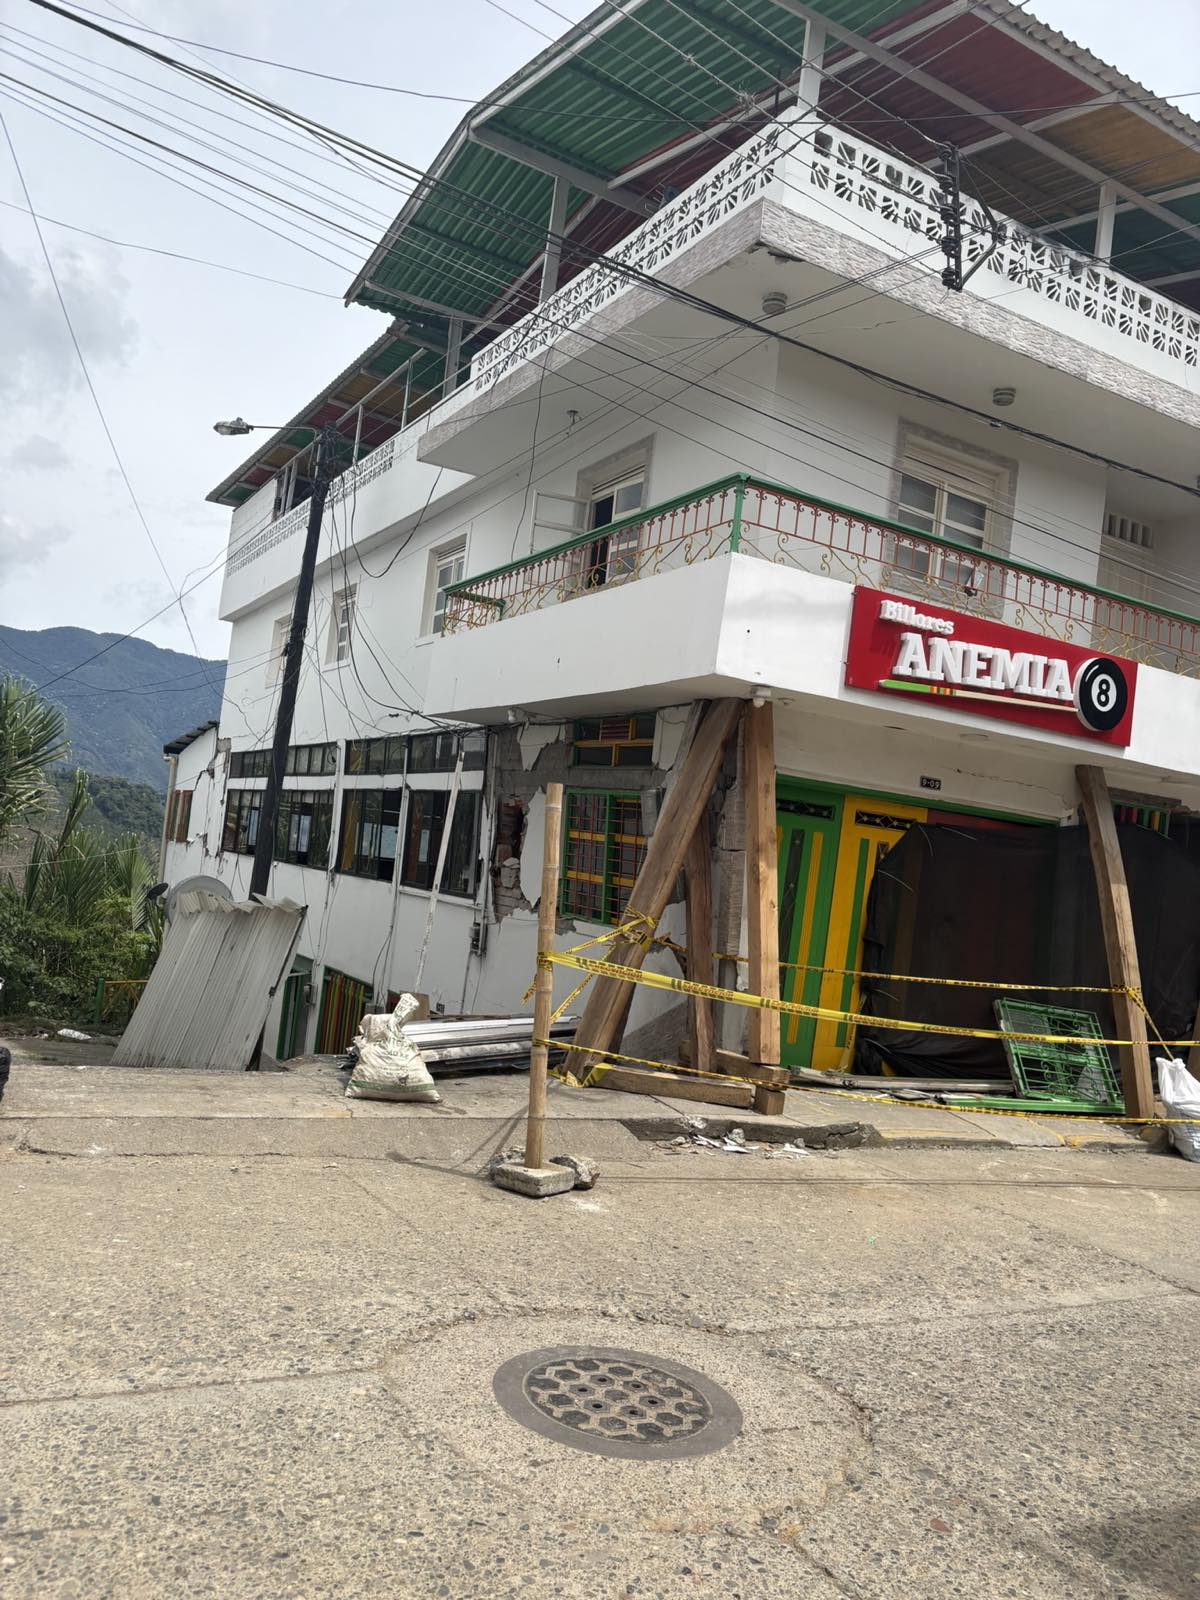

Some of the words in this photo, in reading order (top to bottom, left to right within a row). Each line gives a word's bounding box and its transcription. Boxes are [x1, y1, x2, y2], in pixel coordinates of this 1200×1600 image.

[880, 600, 954, 635] Billares
[892, 632, 1074, 700] ANEMIA
[1097, 678, 1111, 708] 8
